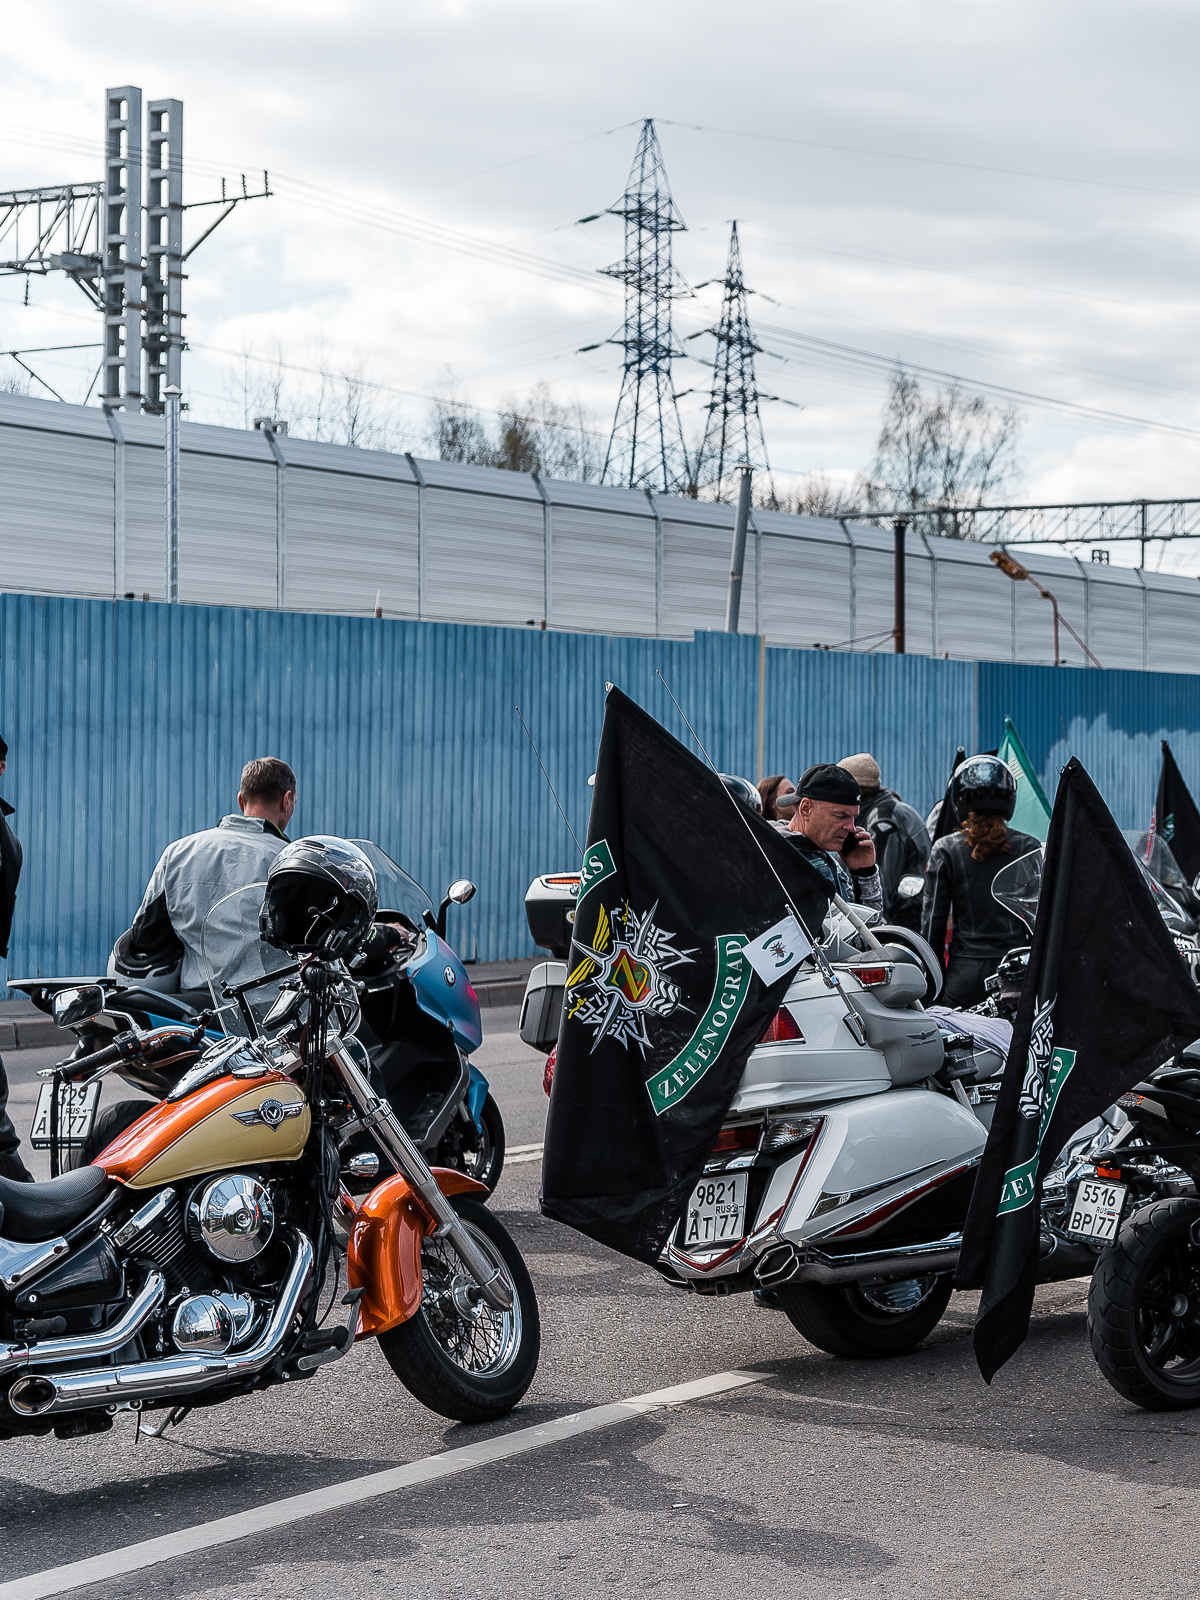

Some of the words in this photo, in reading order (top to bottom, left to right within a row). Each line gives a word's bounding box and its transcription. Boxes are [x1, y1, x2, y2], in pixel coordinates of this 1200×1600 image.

[658, 940, 743, 1099] ZELENOGRAD
[49, 1088, 88, 1106] 329
[697, 1180, 736, 1207] 9821
[1082, 1184, 1117, 1207] 5516
[716, 1204, 731, 1214] RUS
[720, 1213, 739, 1237] 77
[1097, 1217, 1115, 1236] 77
